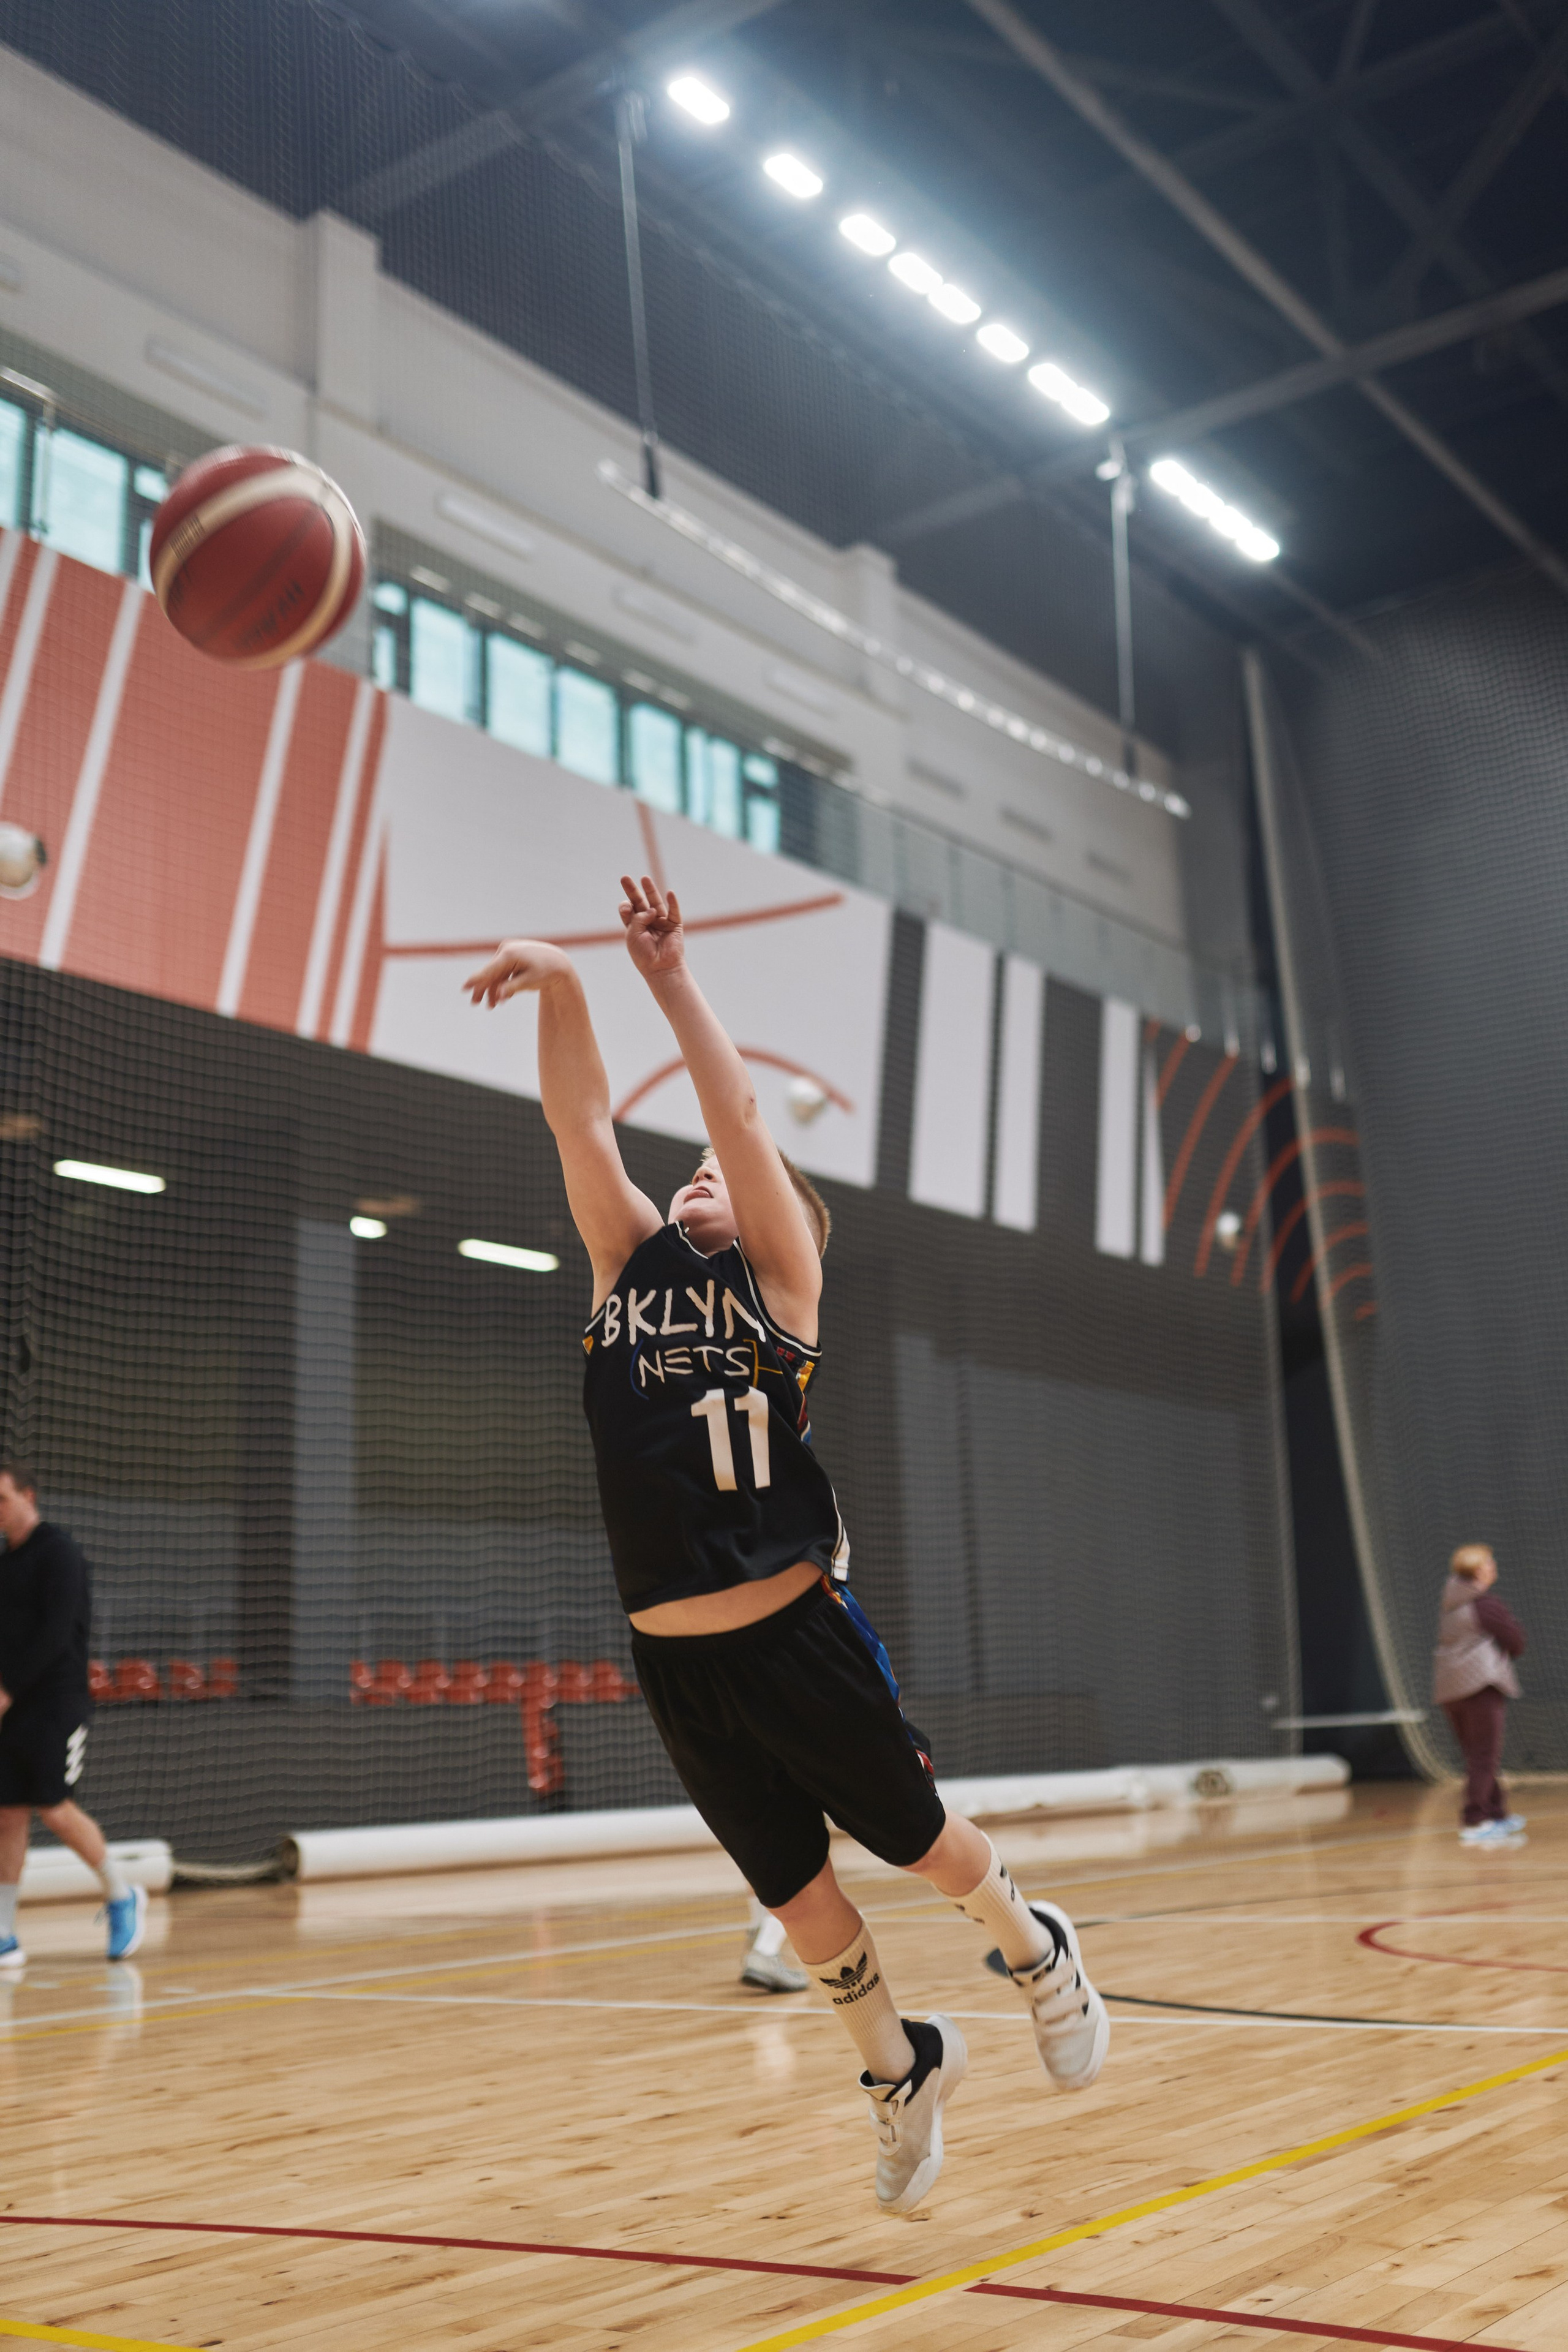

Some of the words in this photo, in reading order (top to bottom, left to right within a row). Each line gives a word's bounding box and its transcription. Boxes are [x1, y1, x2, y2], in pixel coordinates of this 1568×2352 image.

[601, 1279, 766, 1348] BKLYN
[638, 1345, 752, 1388] NETS
[690, 1385, 771, 1492] 11
[832, 1972, 880, 2005] adidas
